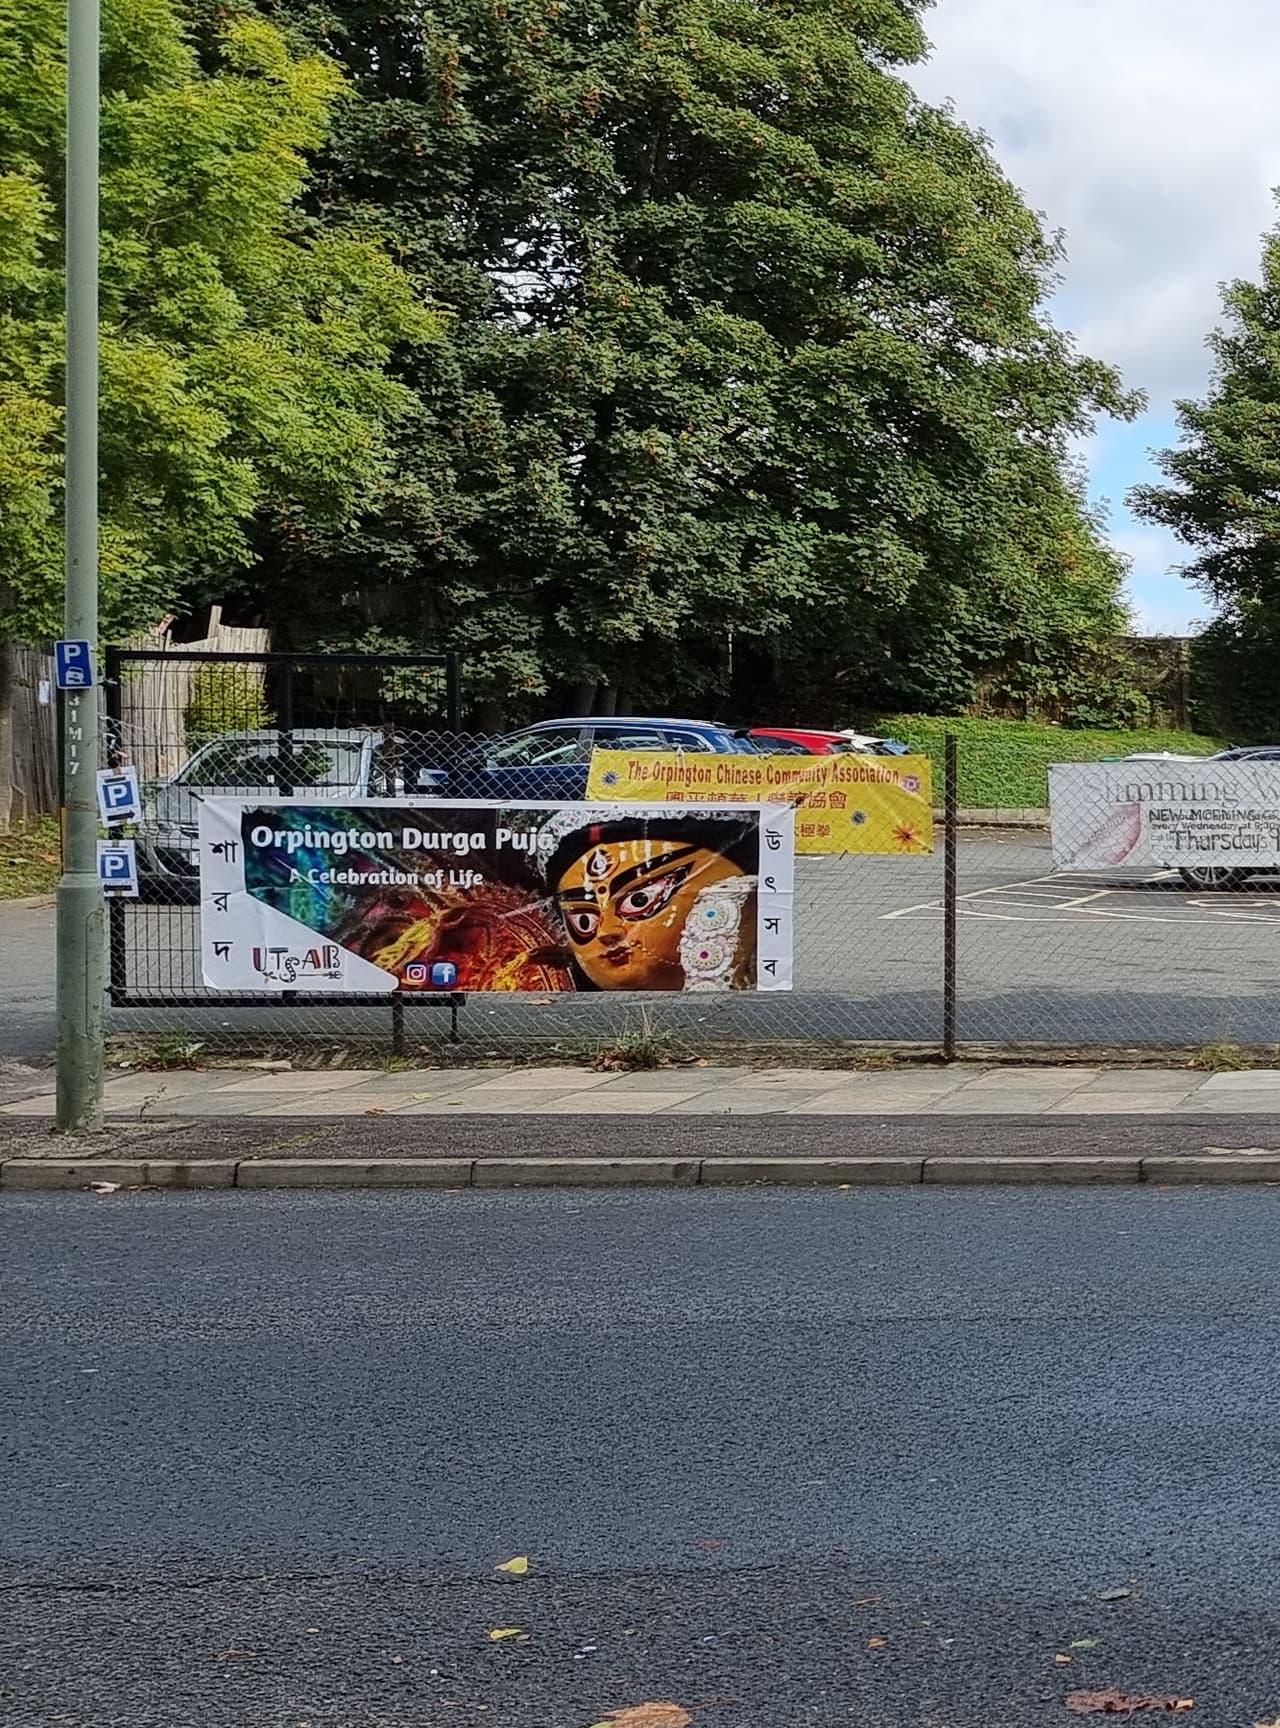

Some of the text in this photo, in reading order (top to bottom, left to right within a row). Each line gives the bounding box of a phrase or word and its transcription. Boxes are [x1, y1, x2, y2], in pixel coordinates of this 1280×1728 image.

[64, 645, 81, 664] P
[627, 760, 900, 787] The Orpington Chinese Community Association
[108, 784, 128, 806] P
[250, 825, 554, 857] Orpington Durga Puja
[105, 855, 124, 877] P
[289, 867, 484, 887] A Celebration of Life
